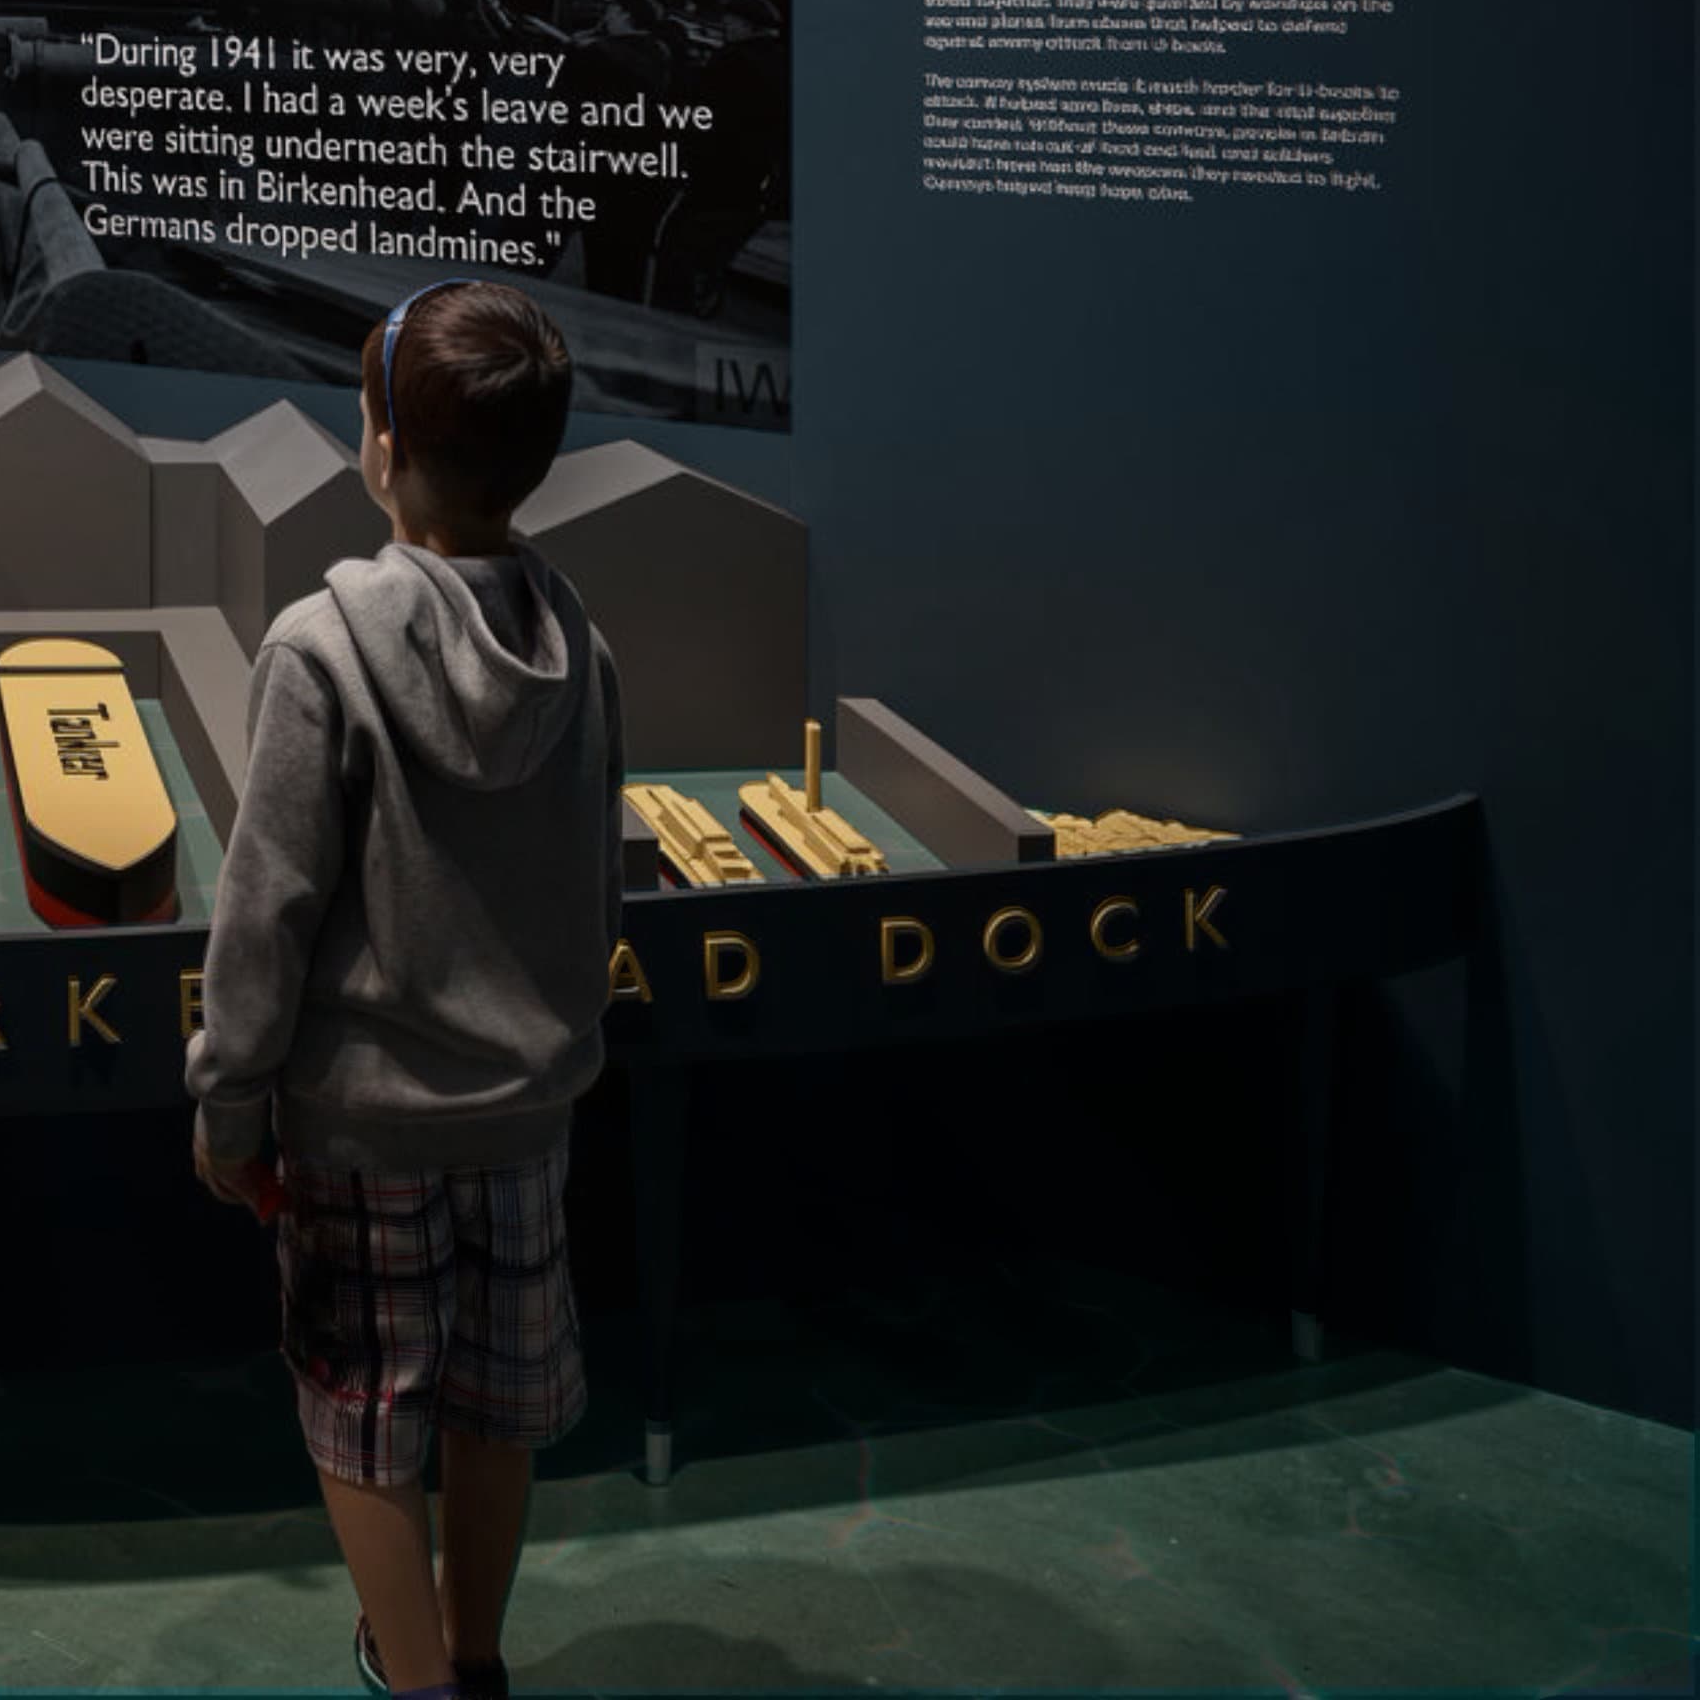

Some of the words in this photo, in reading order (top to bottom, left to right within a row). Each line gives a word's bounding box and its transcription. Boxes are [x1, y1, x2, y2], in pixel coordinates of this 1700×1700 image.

[211, 36, 276, 69] 1941
[292, 39, 314, 70] it
[323, 48, 385, 72] was
[395, 50, 477, 83] very,
[489, 53, 565, 87] very
[81, 82, 232, 113] desperate.
[243, 81, 252, 113] I
[262, 83, 319, 115] had
[329, 93, 346, 116] a
[357, 88, 469, 121] week's
[481, 90, 569, 124] leave
[581, 93, 646, 127] and
[658, 105, 713, 130] we
[81, 128, 154, 151] were
[165, 125, 255, 166] sitting
[265, 133, 447, 165] underneath
[461, 136, 515, 170] the
[528, 142, 688, 177] stairwell.
[82, 160, 143, 194] This
[152, 174, 208, 198] was
[219, 169, 245, 200] in
[257, 171, 445, 211] Birkenhead.
[457, 182, 527, 217] And
[540, 186, 596, 220] the
[84, 204, 217, 243] Germans
[225, 216, 358, 255] dropped
[879, 885, 1229, 985] DOCK
